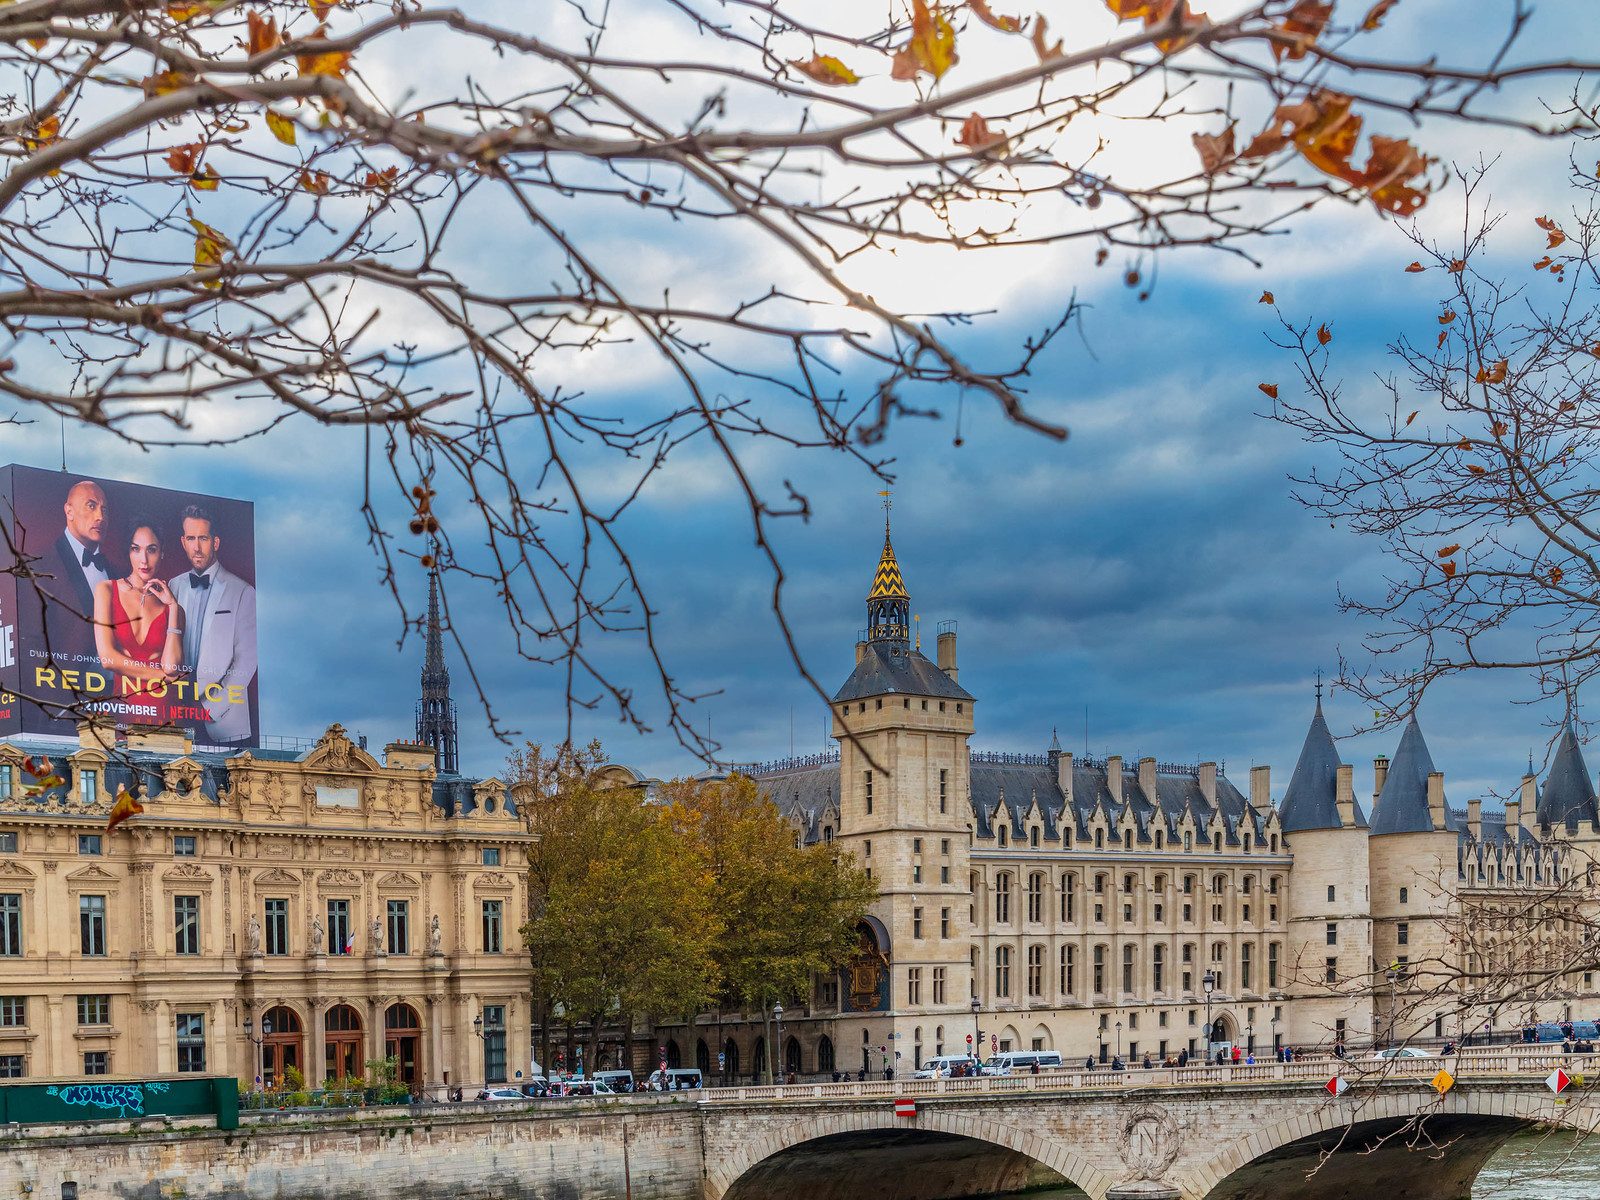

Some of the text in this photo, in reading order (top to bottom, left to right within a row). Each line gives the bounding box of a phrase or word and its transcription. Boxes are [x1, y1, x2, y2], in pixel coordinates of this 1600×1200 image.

[72, 654, 114, 665] JOHNSON
[123, 660, 146, 669] RYAN
[149, 661, 193, 673] REYNOLDS
[35, 666, 245, 705] RED NOTICE
[94, 702, 157, 716] NOVEMBRE
[170, 705, 211, 722] NETFLIX
